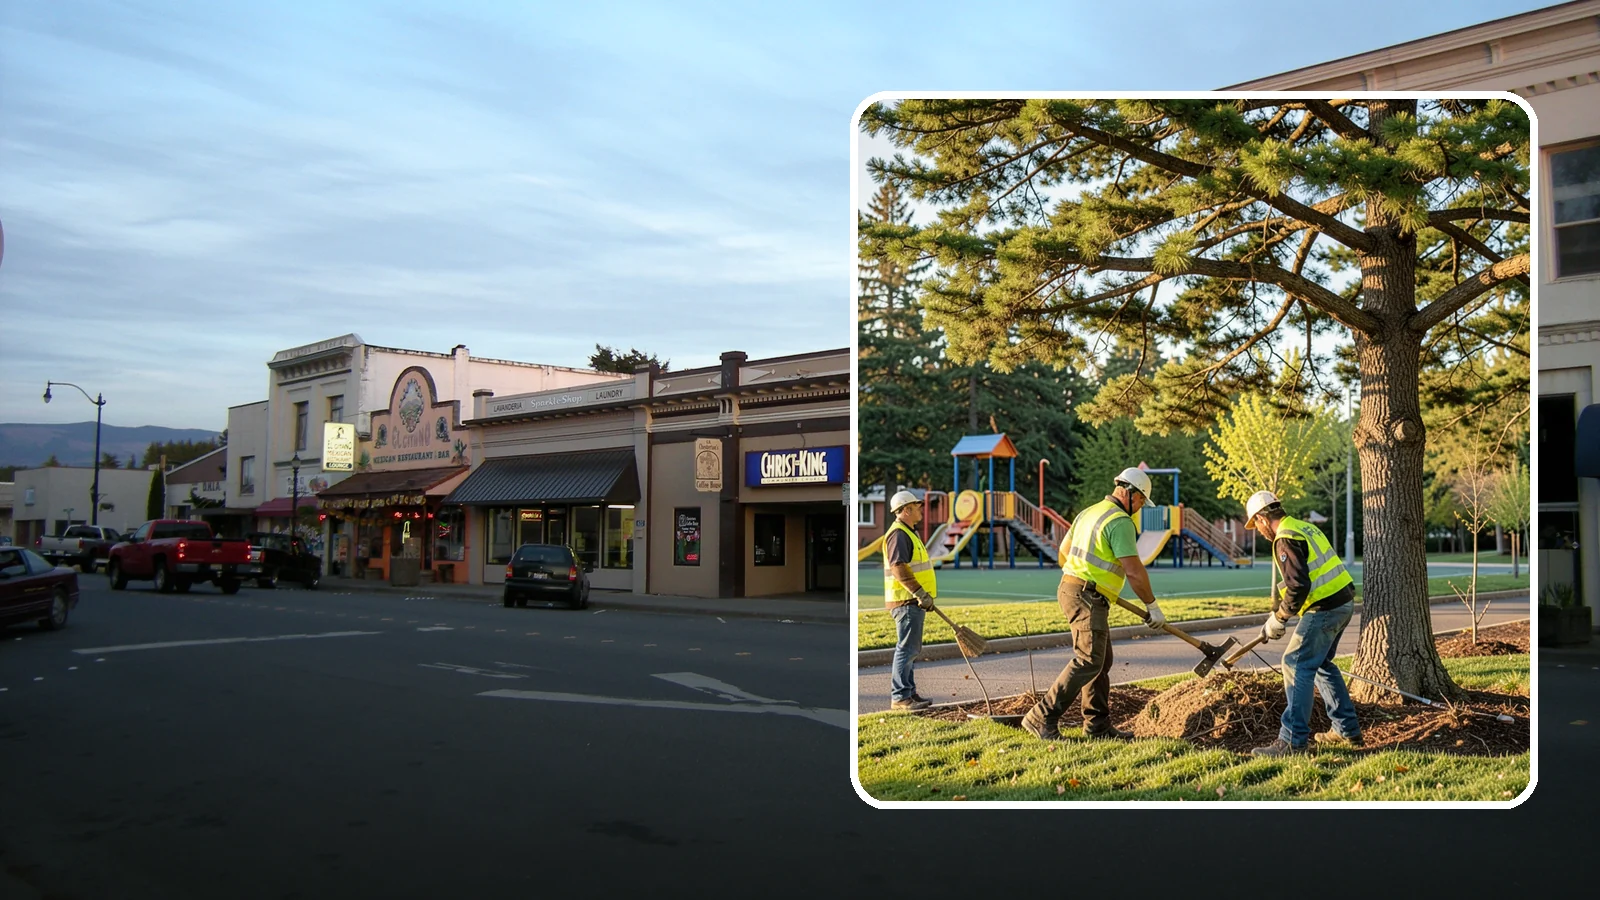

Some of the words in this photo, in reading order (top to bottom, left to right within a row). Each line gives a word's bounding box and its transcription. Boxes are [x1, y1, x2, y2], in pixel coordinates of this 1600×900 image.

[595, 389, 624, 400] LAUNDRY
[493, 402, 523, 413] LAVANDERIA
[530, 396, 560, 409] Sparkle
[373, 454, 396, 464] MEXICAN
[397, 450, 433, 462] RESTAURANT
[438, 450, 450, 459] BAR
[799, 450, 828, 476] KING
